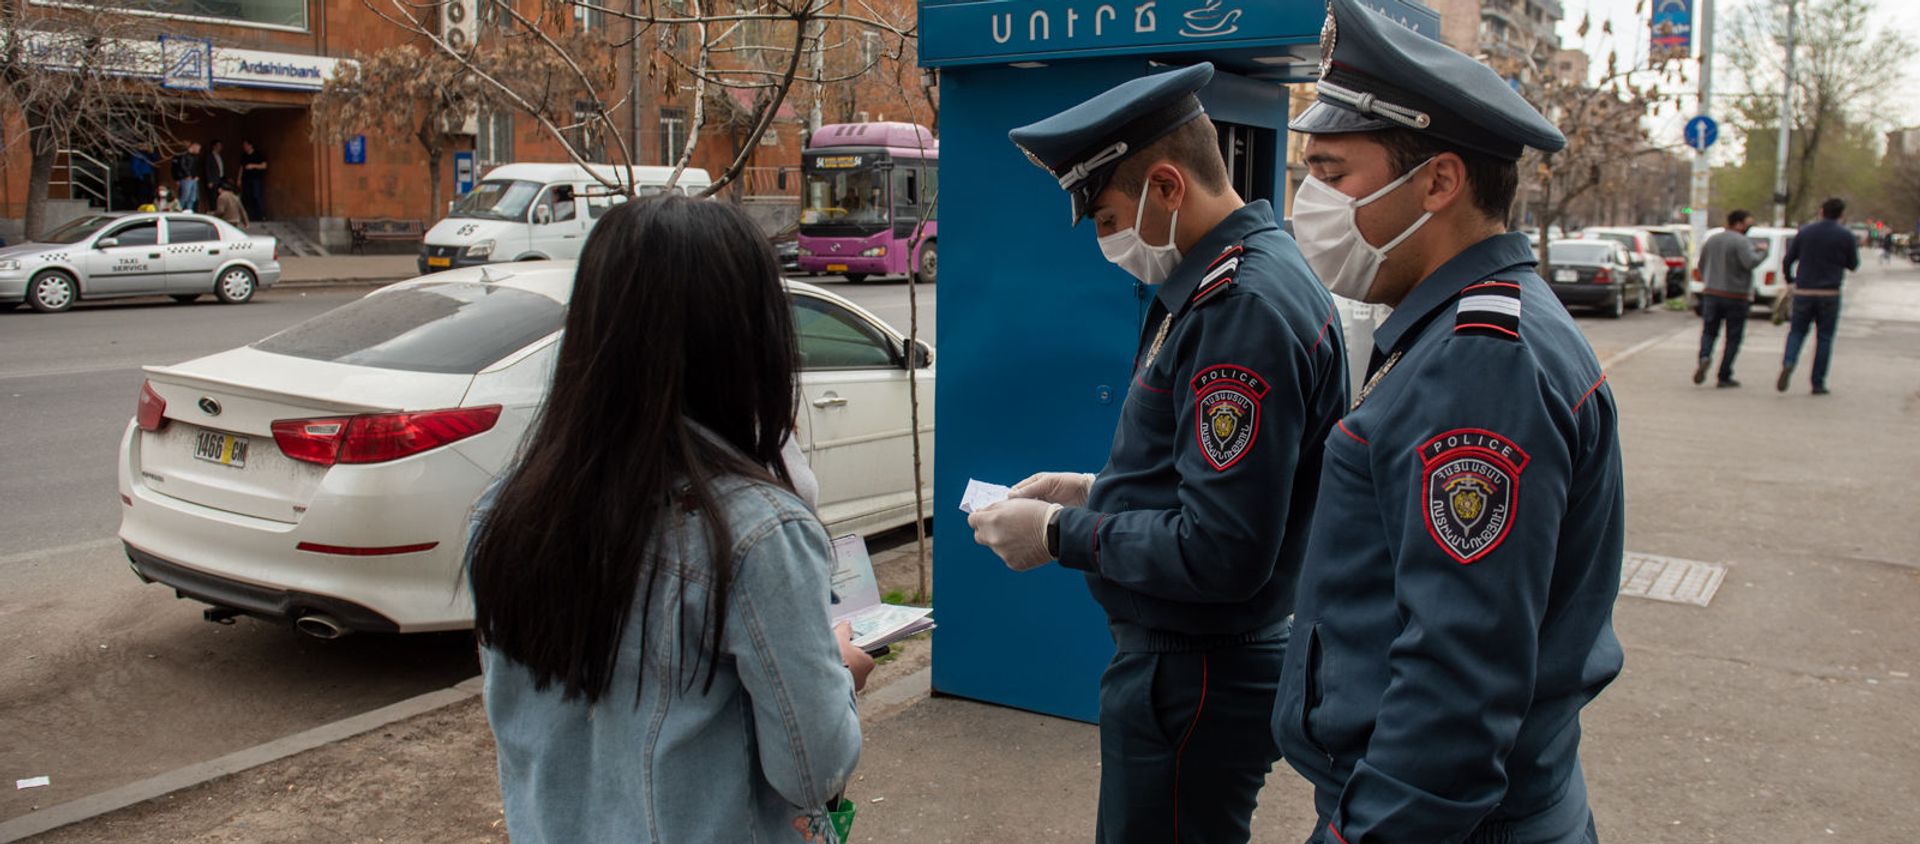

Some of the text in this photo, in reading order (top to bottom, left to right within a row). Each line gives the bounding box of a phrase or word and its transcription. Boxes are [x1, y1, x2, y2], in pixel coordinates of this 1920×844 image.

[992, 1, 1156, 44] ՍՈՒՐՃ
[239, 59, 322, 79] Ardshinbank
[1201, 369, 1258, 388] POLICE
[1205, 392, 1250, 409] ՀԱՅԱՍՏԱՆ
[197, 431, 248, 462] 1466 CM
[1433, 434, 1513, 457] POLICE
[1437, 461, 1502, 485] ՀԱՅԱՍՏԱՆ
[1433, 500, 1505, 550] ՈՍՏԻԿԱՆՈՒԹՅՈՒՆ
